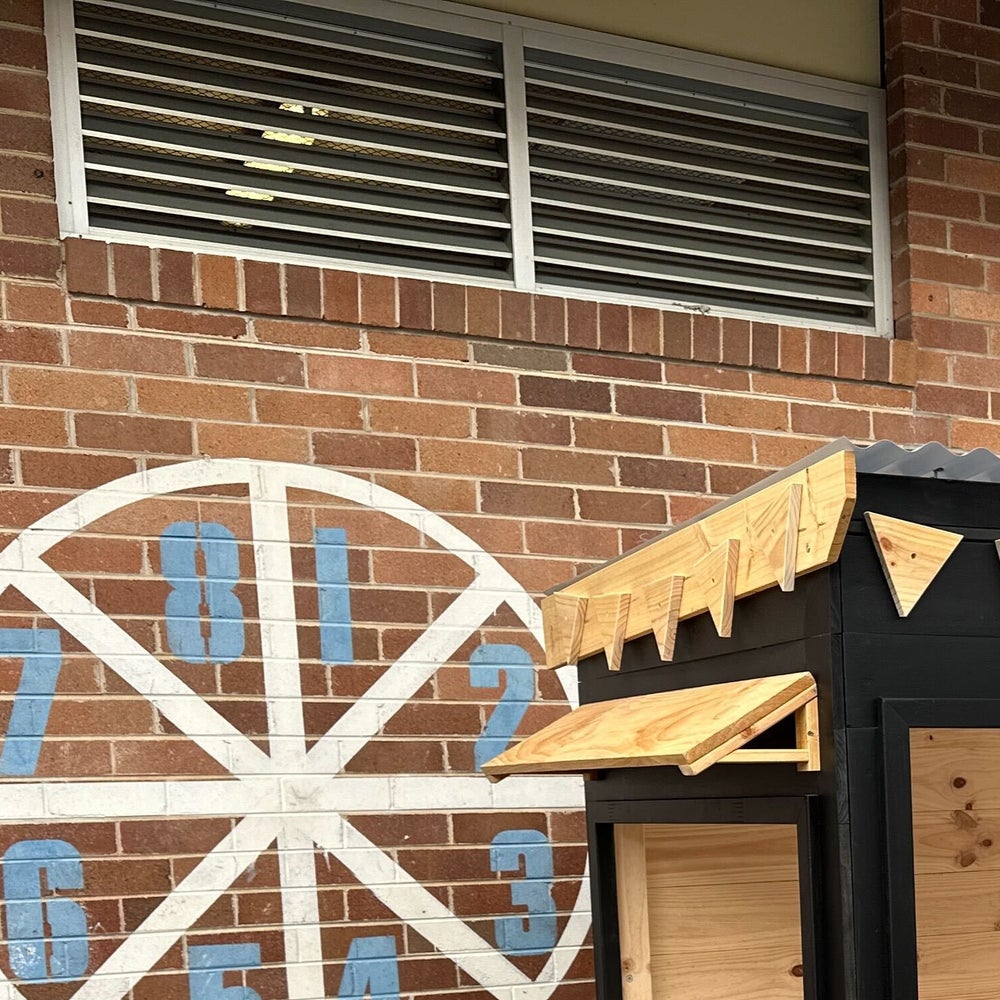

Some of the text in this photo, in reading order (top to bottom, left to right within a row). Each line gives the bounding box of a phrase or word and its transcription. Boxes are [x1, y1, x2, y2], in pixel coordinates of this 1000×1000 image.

[159, 521, 245, 665] 8
[315, 527, 354, 665] 1
[0, 627, 62, 776] 7
[468, 643, 536, 773] 2
[1, 839, 90, 984] 6
[489, 829, 558, 957] 3
